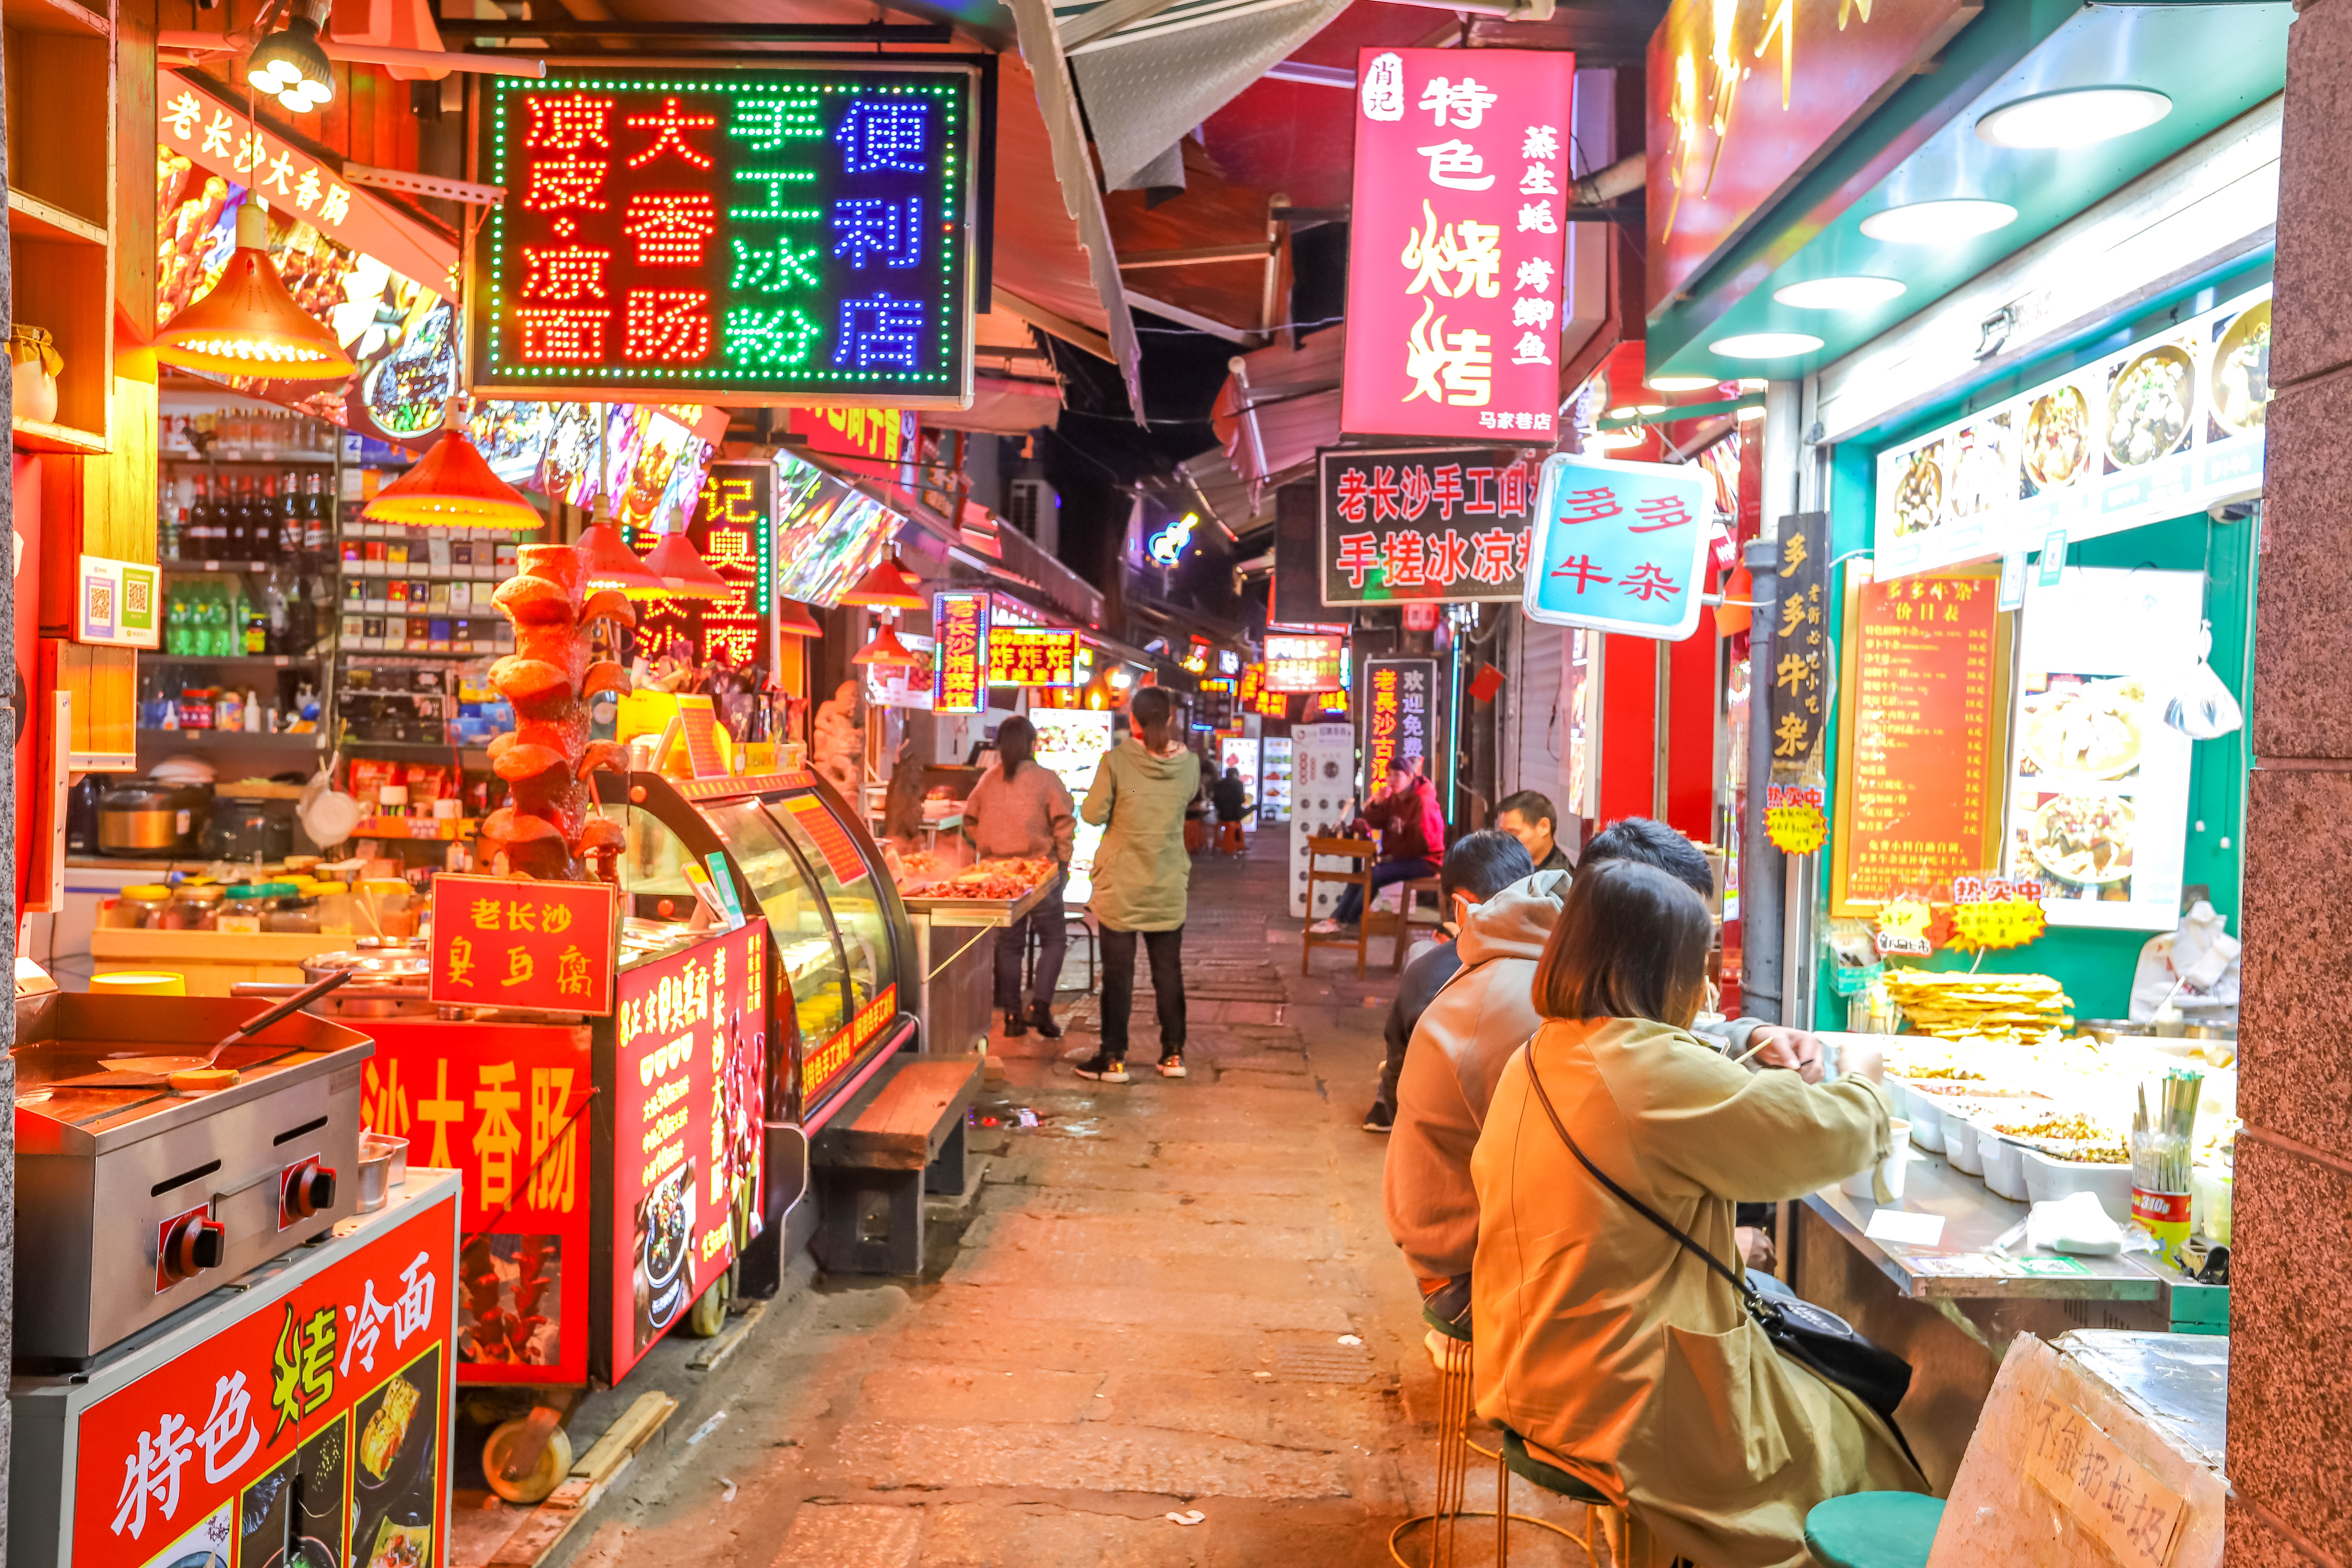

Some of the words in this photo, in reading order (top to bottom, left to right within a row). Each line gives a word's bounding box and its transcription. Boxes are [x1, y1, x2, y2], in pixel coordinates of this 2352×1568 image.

[1370, 60, 1397, 113] 肖记
[161, 90, 351, 227] 老长沙大香肠
[1516, 125, 1560, 234] 蒸生蚝
[623, 97, 717, 363] 大香肠
[725, 96, 826, 366] 手工冰粉
[832, 100, 929, 369] 便利店
[1401, 77, 1502, 407] 特色烧烤
[1511, 257, 1555, 366] 烤鲫鱼
[1478, 411, 1553, 431] 马家巷店
[1559, 486, 1692, 534] 多多
[1551, 554, 1681, 603] 牛杂
[989, 645, 1072, 670] 炸炸炸
[1774, 531, 1808, 757] 多多牛杂
[447, 935, 593, 998] 臭豆腐
[470, 897, 573, 934] 老长沙
[110, 1250, 437, 1541] 特色烤冷面
